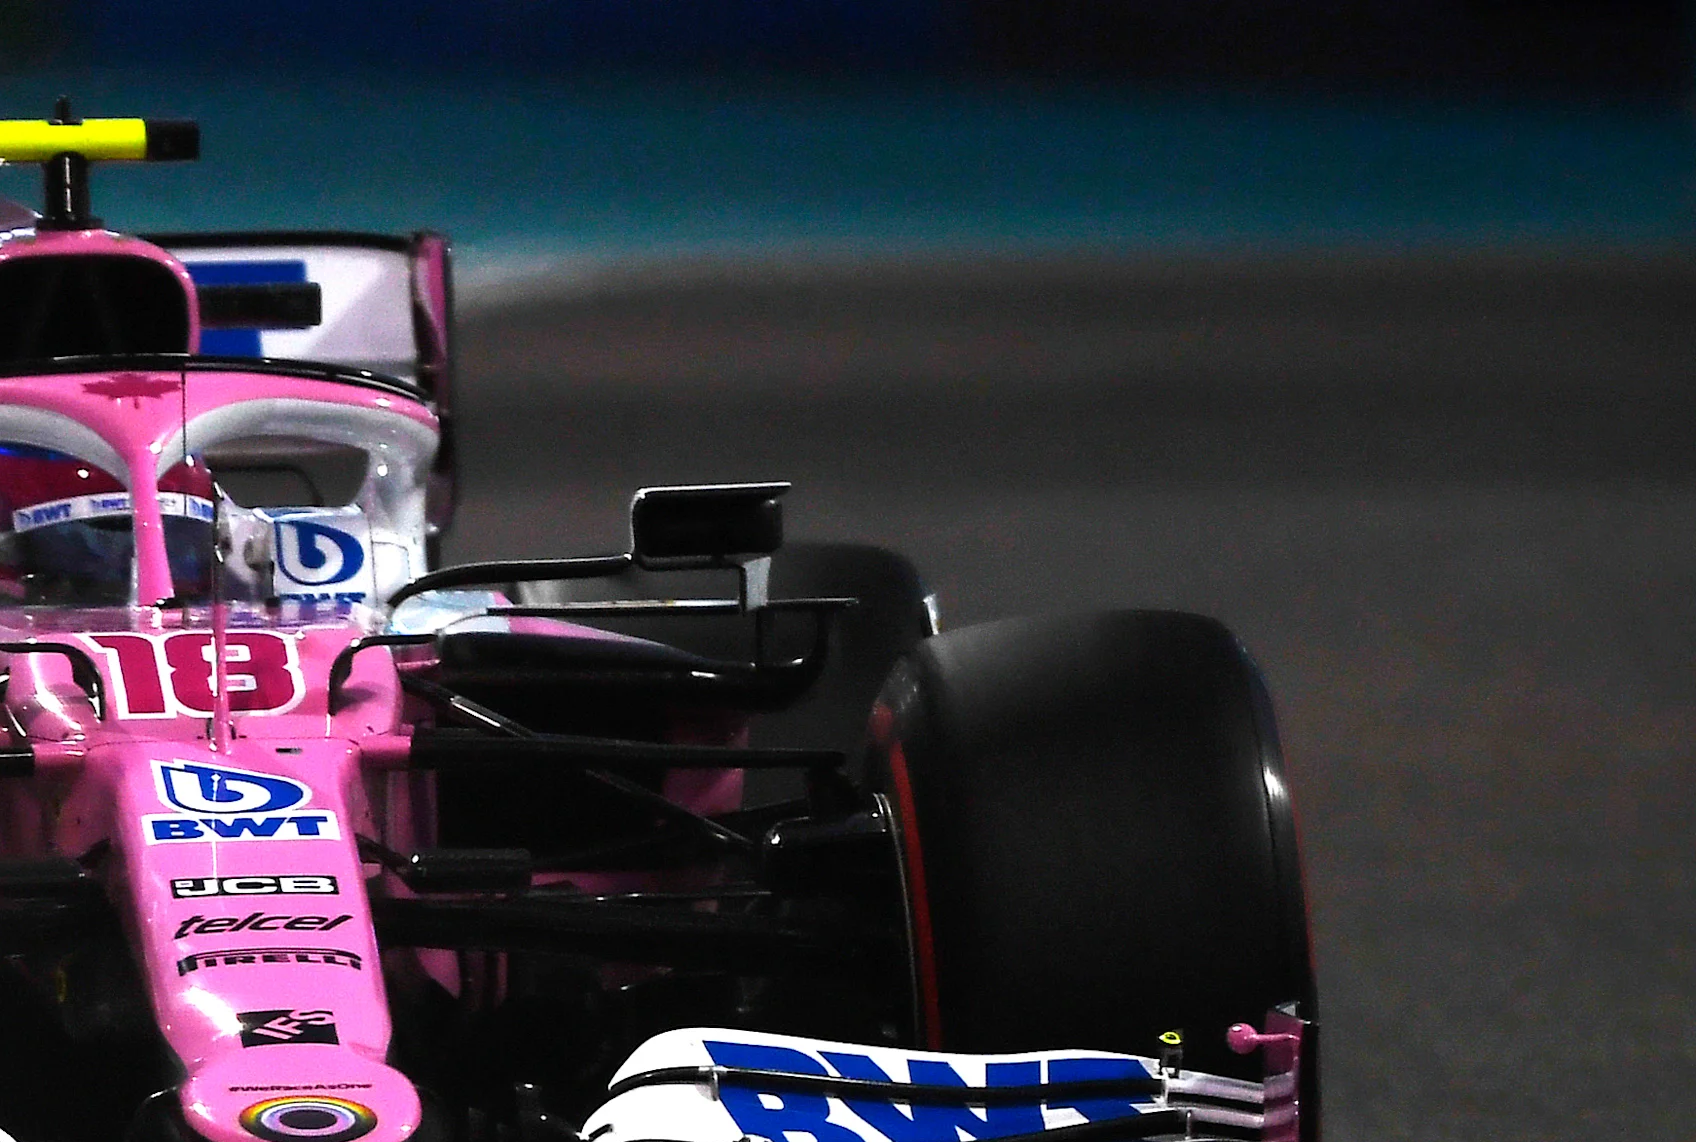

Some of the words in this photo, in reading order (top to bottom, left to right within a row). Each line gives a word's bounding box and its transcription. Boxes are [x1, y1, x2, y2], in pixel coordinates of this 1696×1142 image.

[86, 629, 305, 720] 18
[152, 815, 329, 840] BWT
[174, 876, 336, 897] JCB
[173, 912, 354, 940] telcel
[177, 947, 363, 977] PIRELLI
